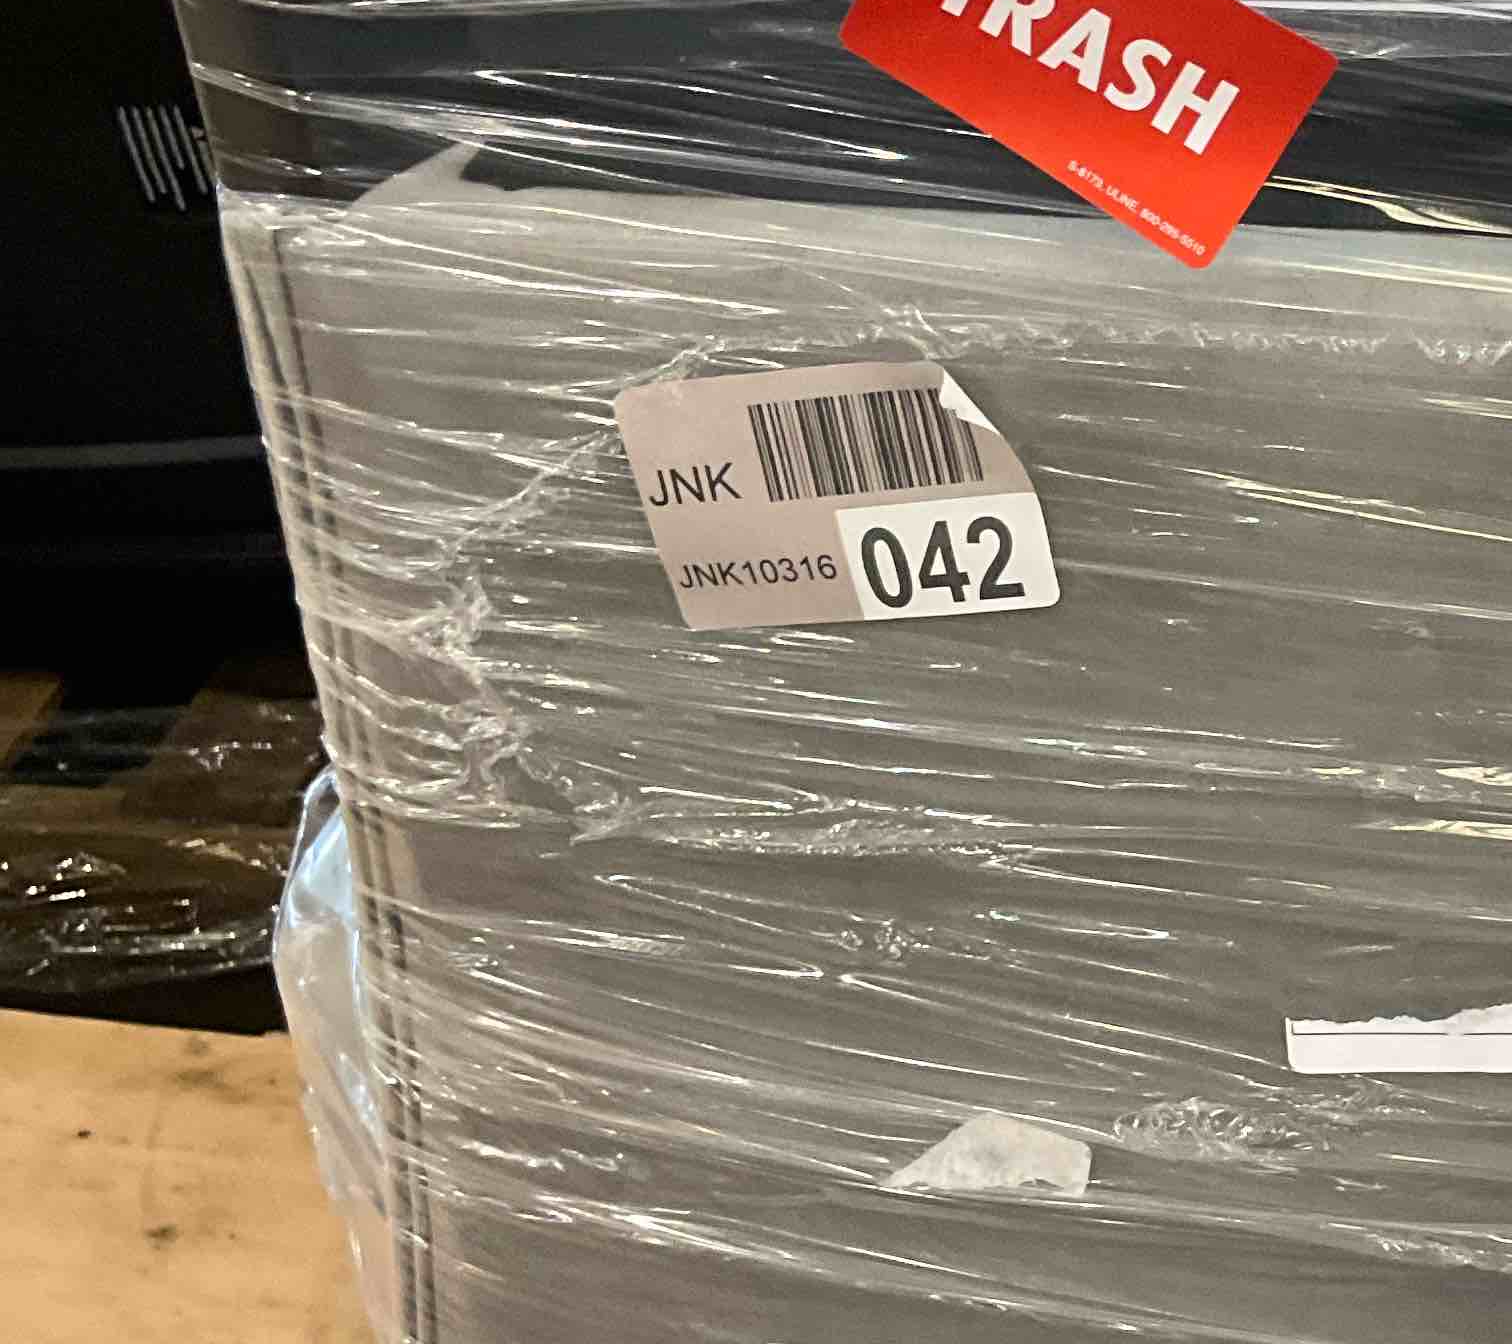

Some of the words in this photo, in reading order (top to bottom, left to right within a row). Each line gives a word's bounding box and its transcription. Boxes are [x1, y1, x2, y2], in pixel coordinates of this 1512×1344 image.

[649, 462, 743, 507] JNK
[679, 554, 838, 589] JNK10316
[861, 516, 1025, 609] 042
